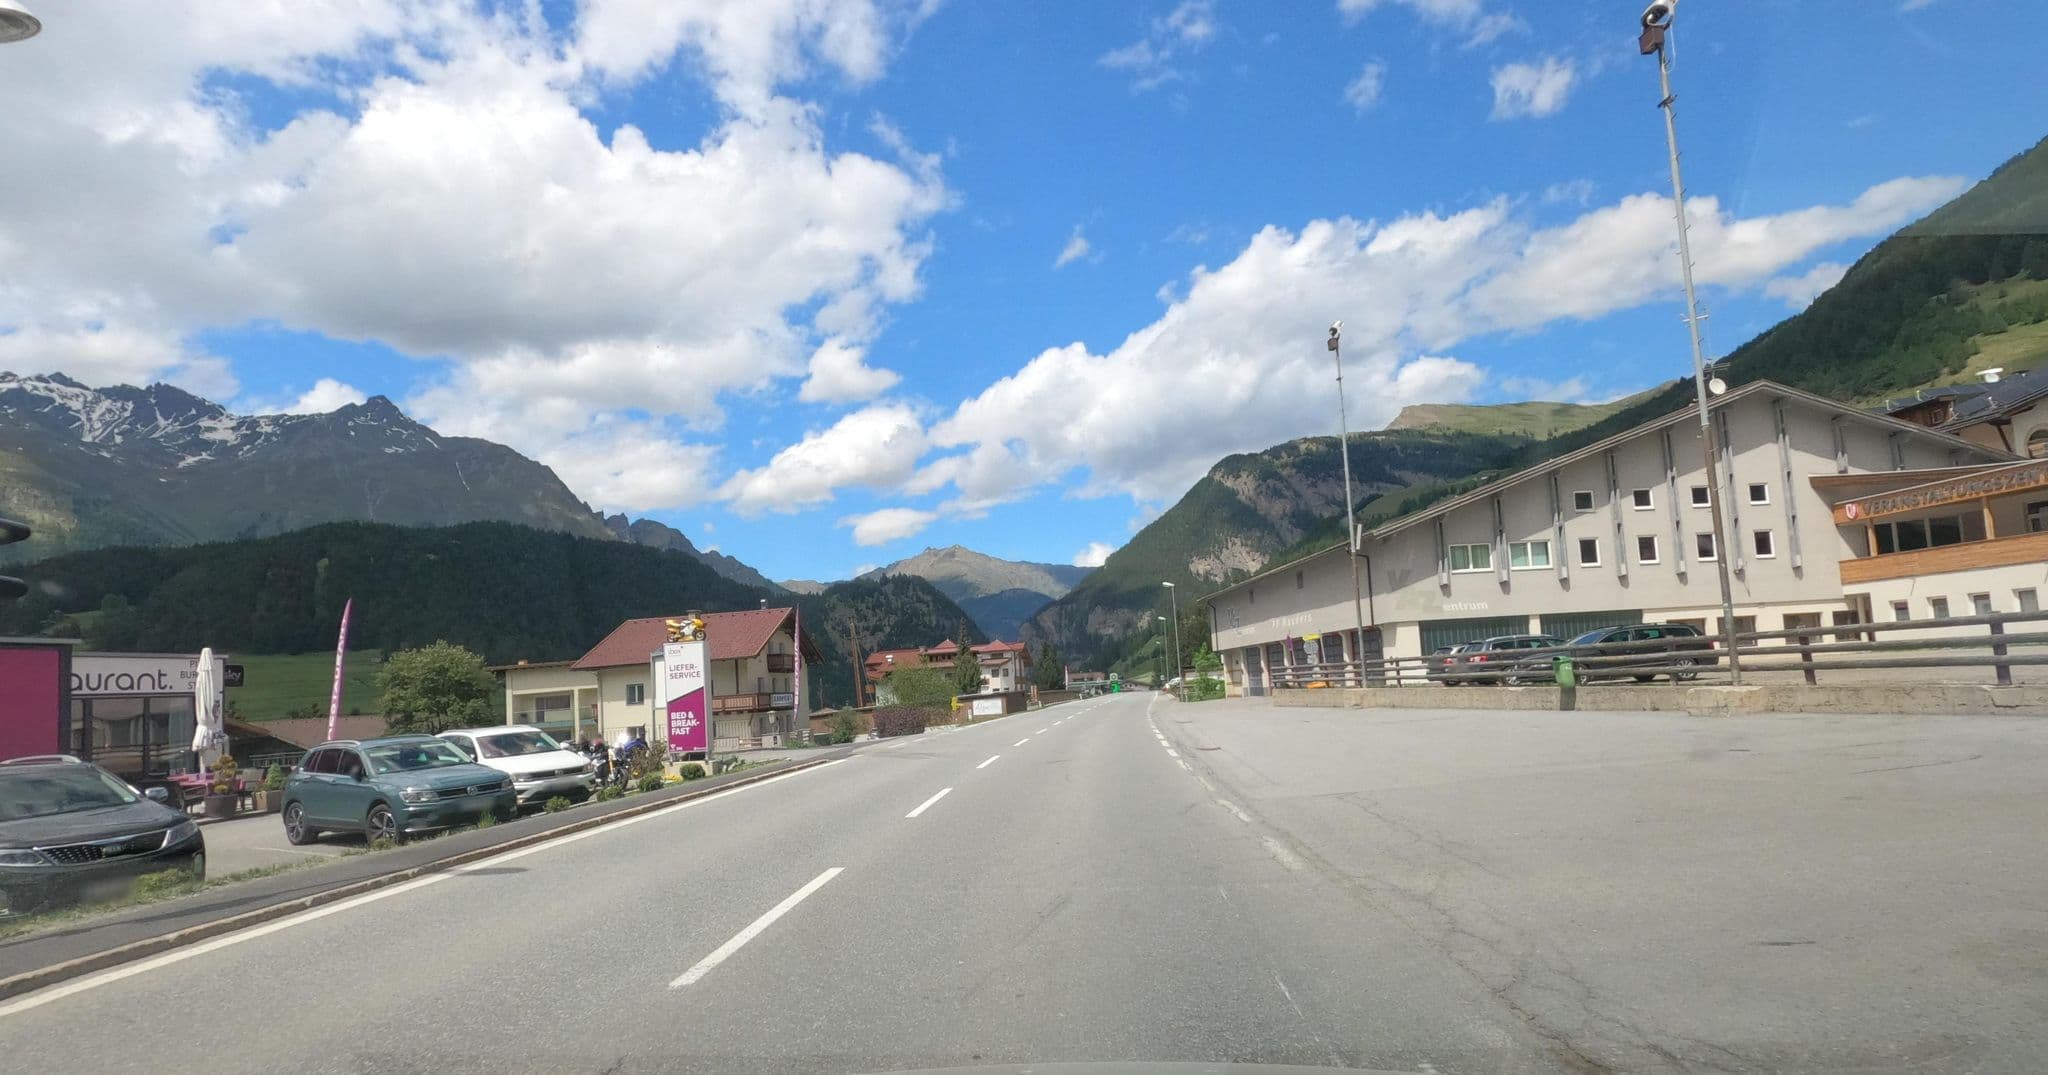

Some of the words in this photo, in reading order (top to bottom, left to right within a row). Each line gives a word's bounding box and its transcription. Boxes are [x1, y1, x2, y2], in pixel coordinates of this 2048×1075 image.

[669, 663, 698, 672] LIEFER-
[180, 670, 198, 679] BUR
[669, 671, 701, 680] SERVICE
[671, 711, 687, 720] BED
[688, 711, 694, 719] &
[671, 719, 700, 728] BREAK-
[672, 727, 690, 735] FAST
